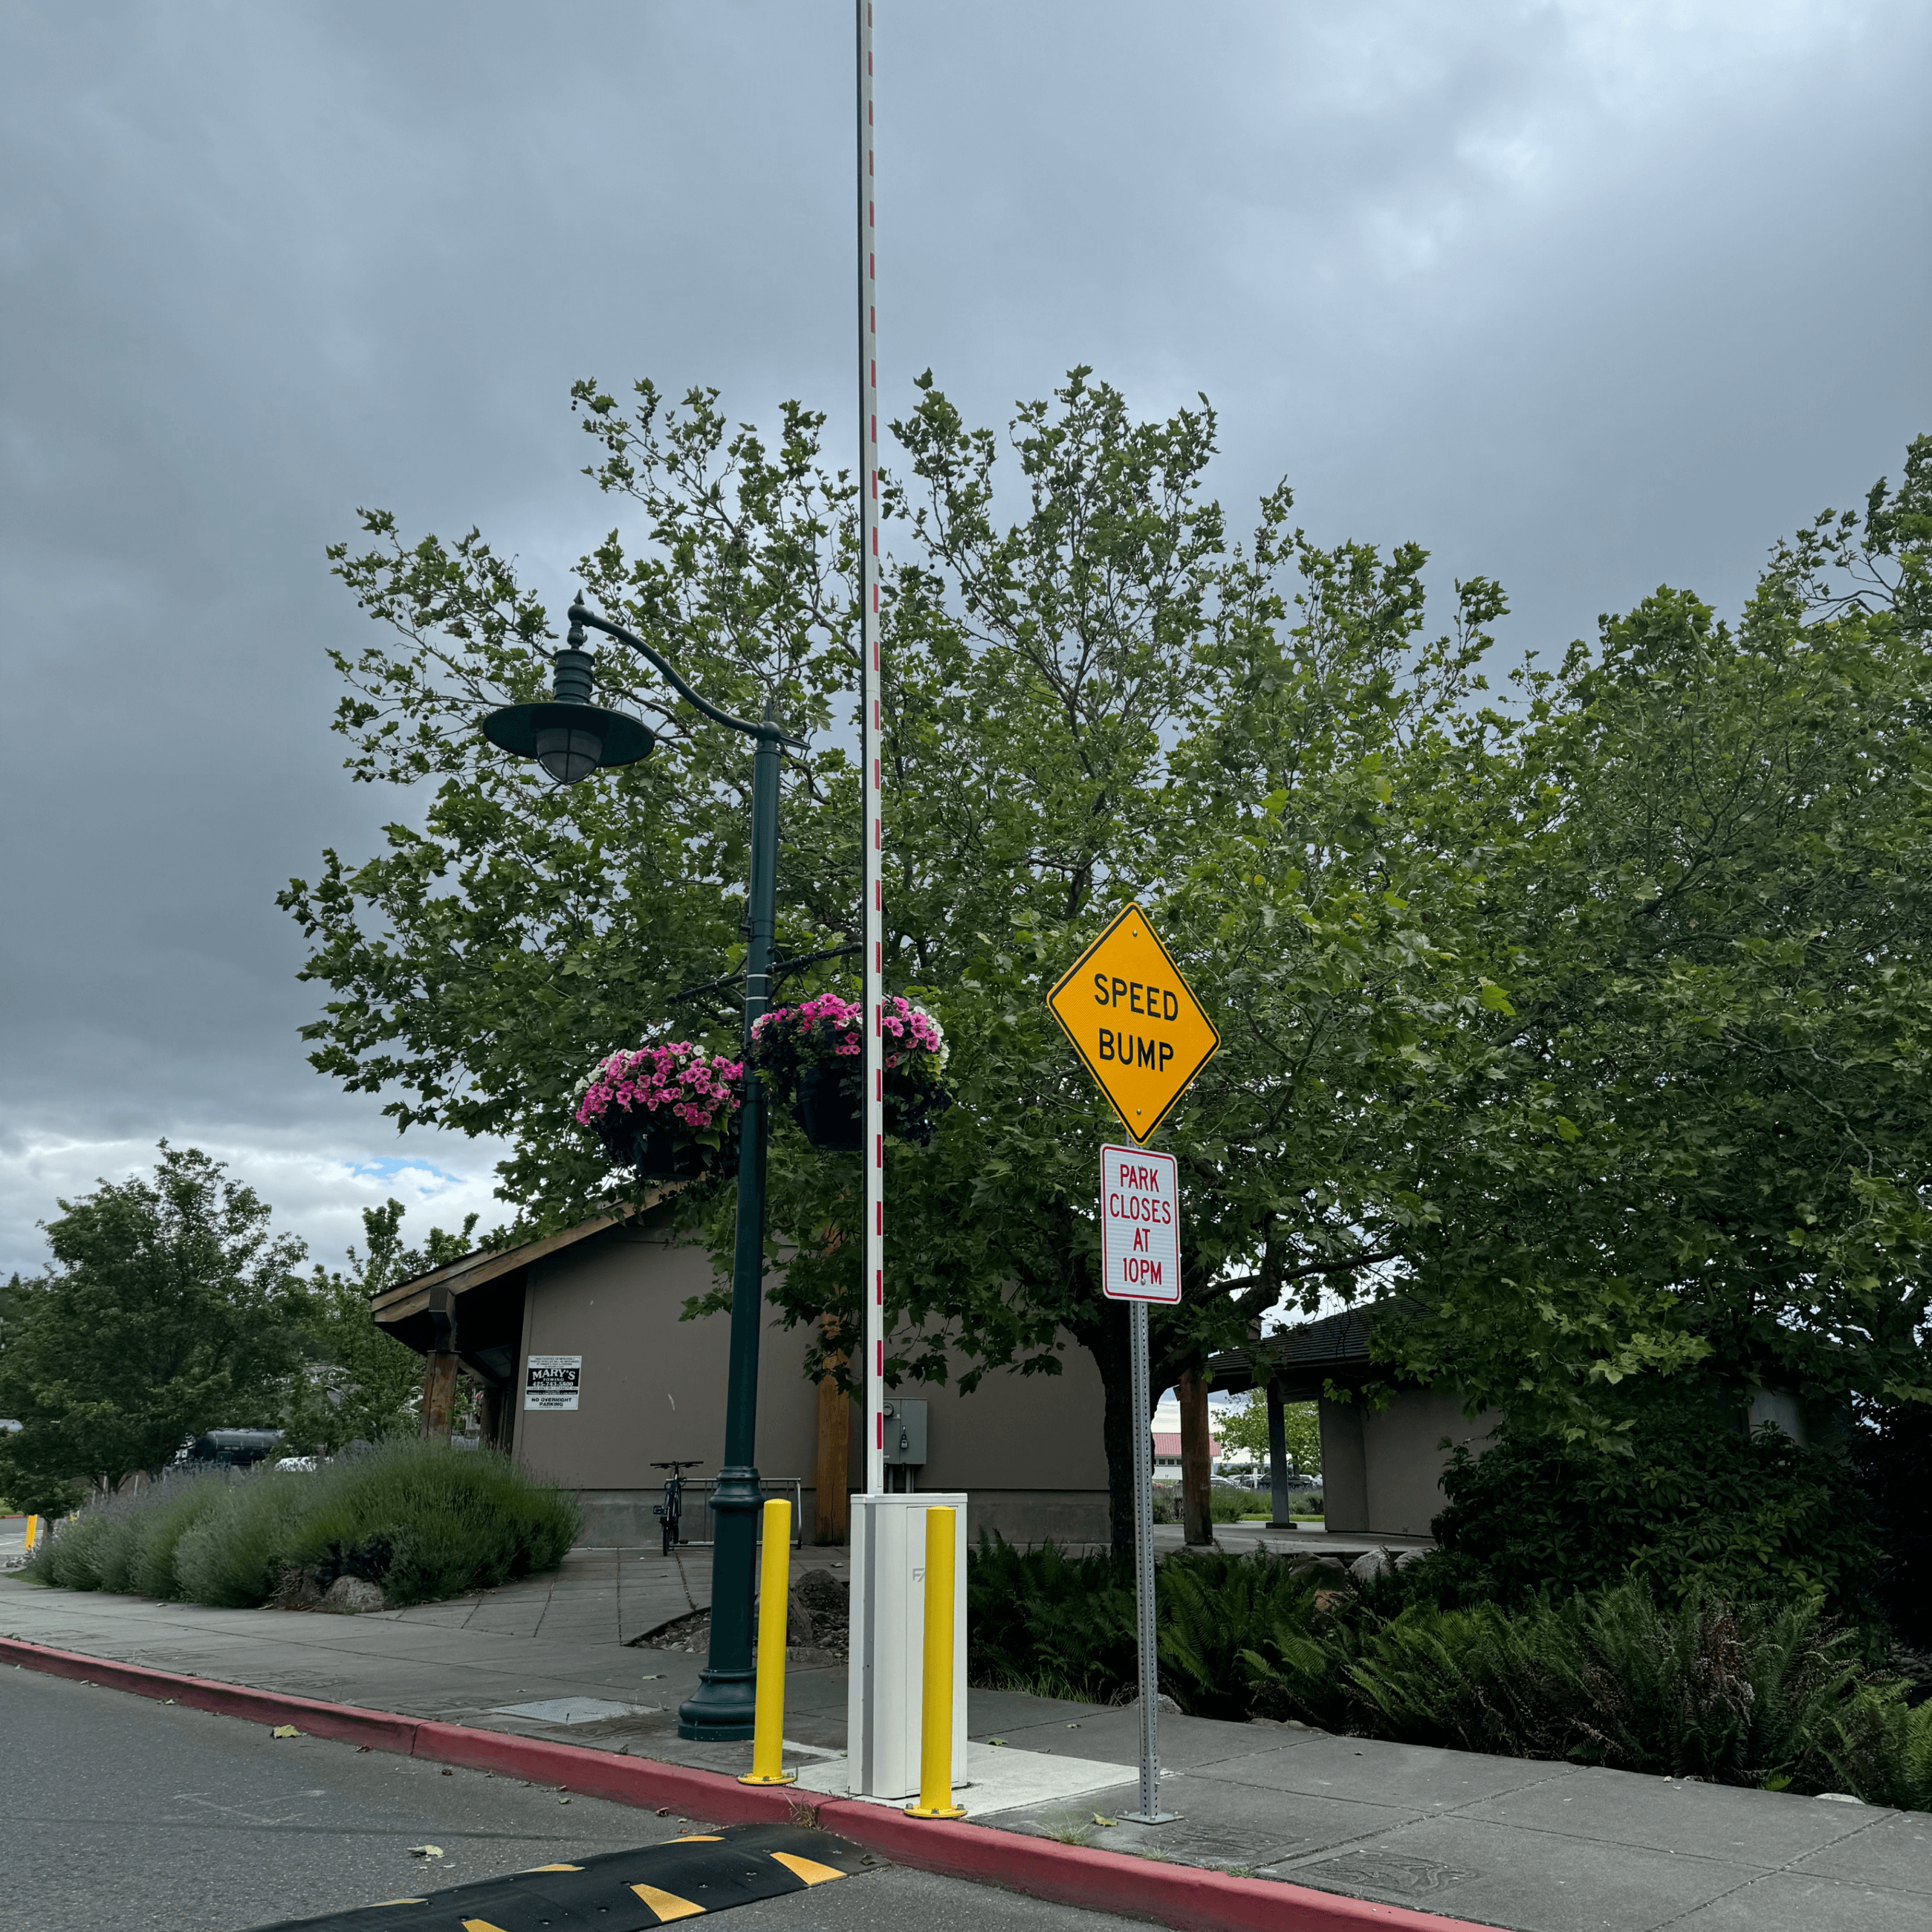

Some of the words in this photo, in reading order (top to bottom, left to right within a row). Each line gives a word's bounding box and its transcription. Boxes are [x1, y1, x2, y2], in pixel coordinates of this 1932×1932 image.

[1094, 973, 1179, 1021] SPEED
[1099, 1028, 1174, 1072] BUMP
[1120, 1163, 1159, 1193] PARK
[1109, 1193, 1171, 1225] CLOSES
[1133, 1228, 1150, 1253] AT
[1123, 1257, 1162, 1285] 10PM
[532, 1369, 576, 1381] MARY'S
